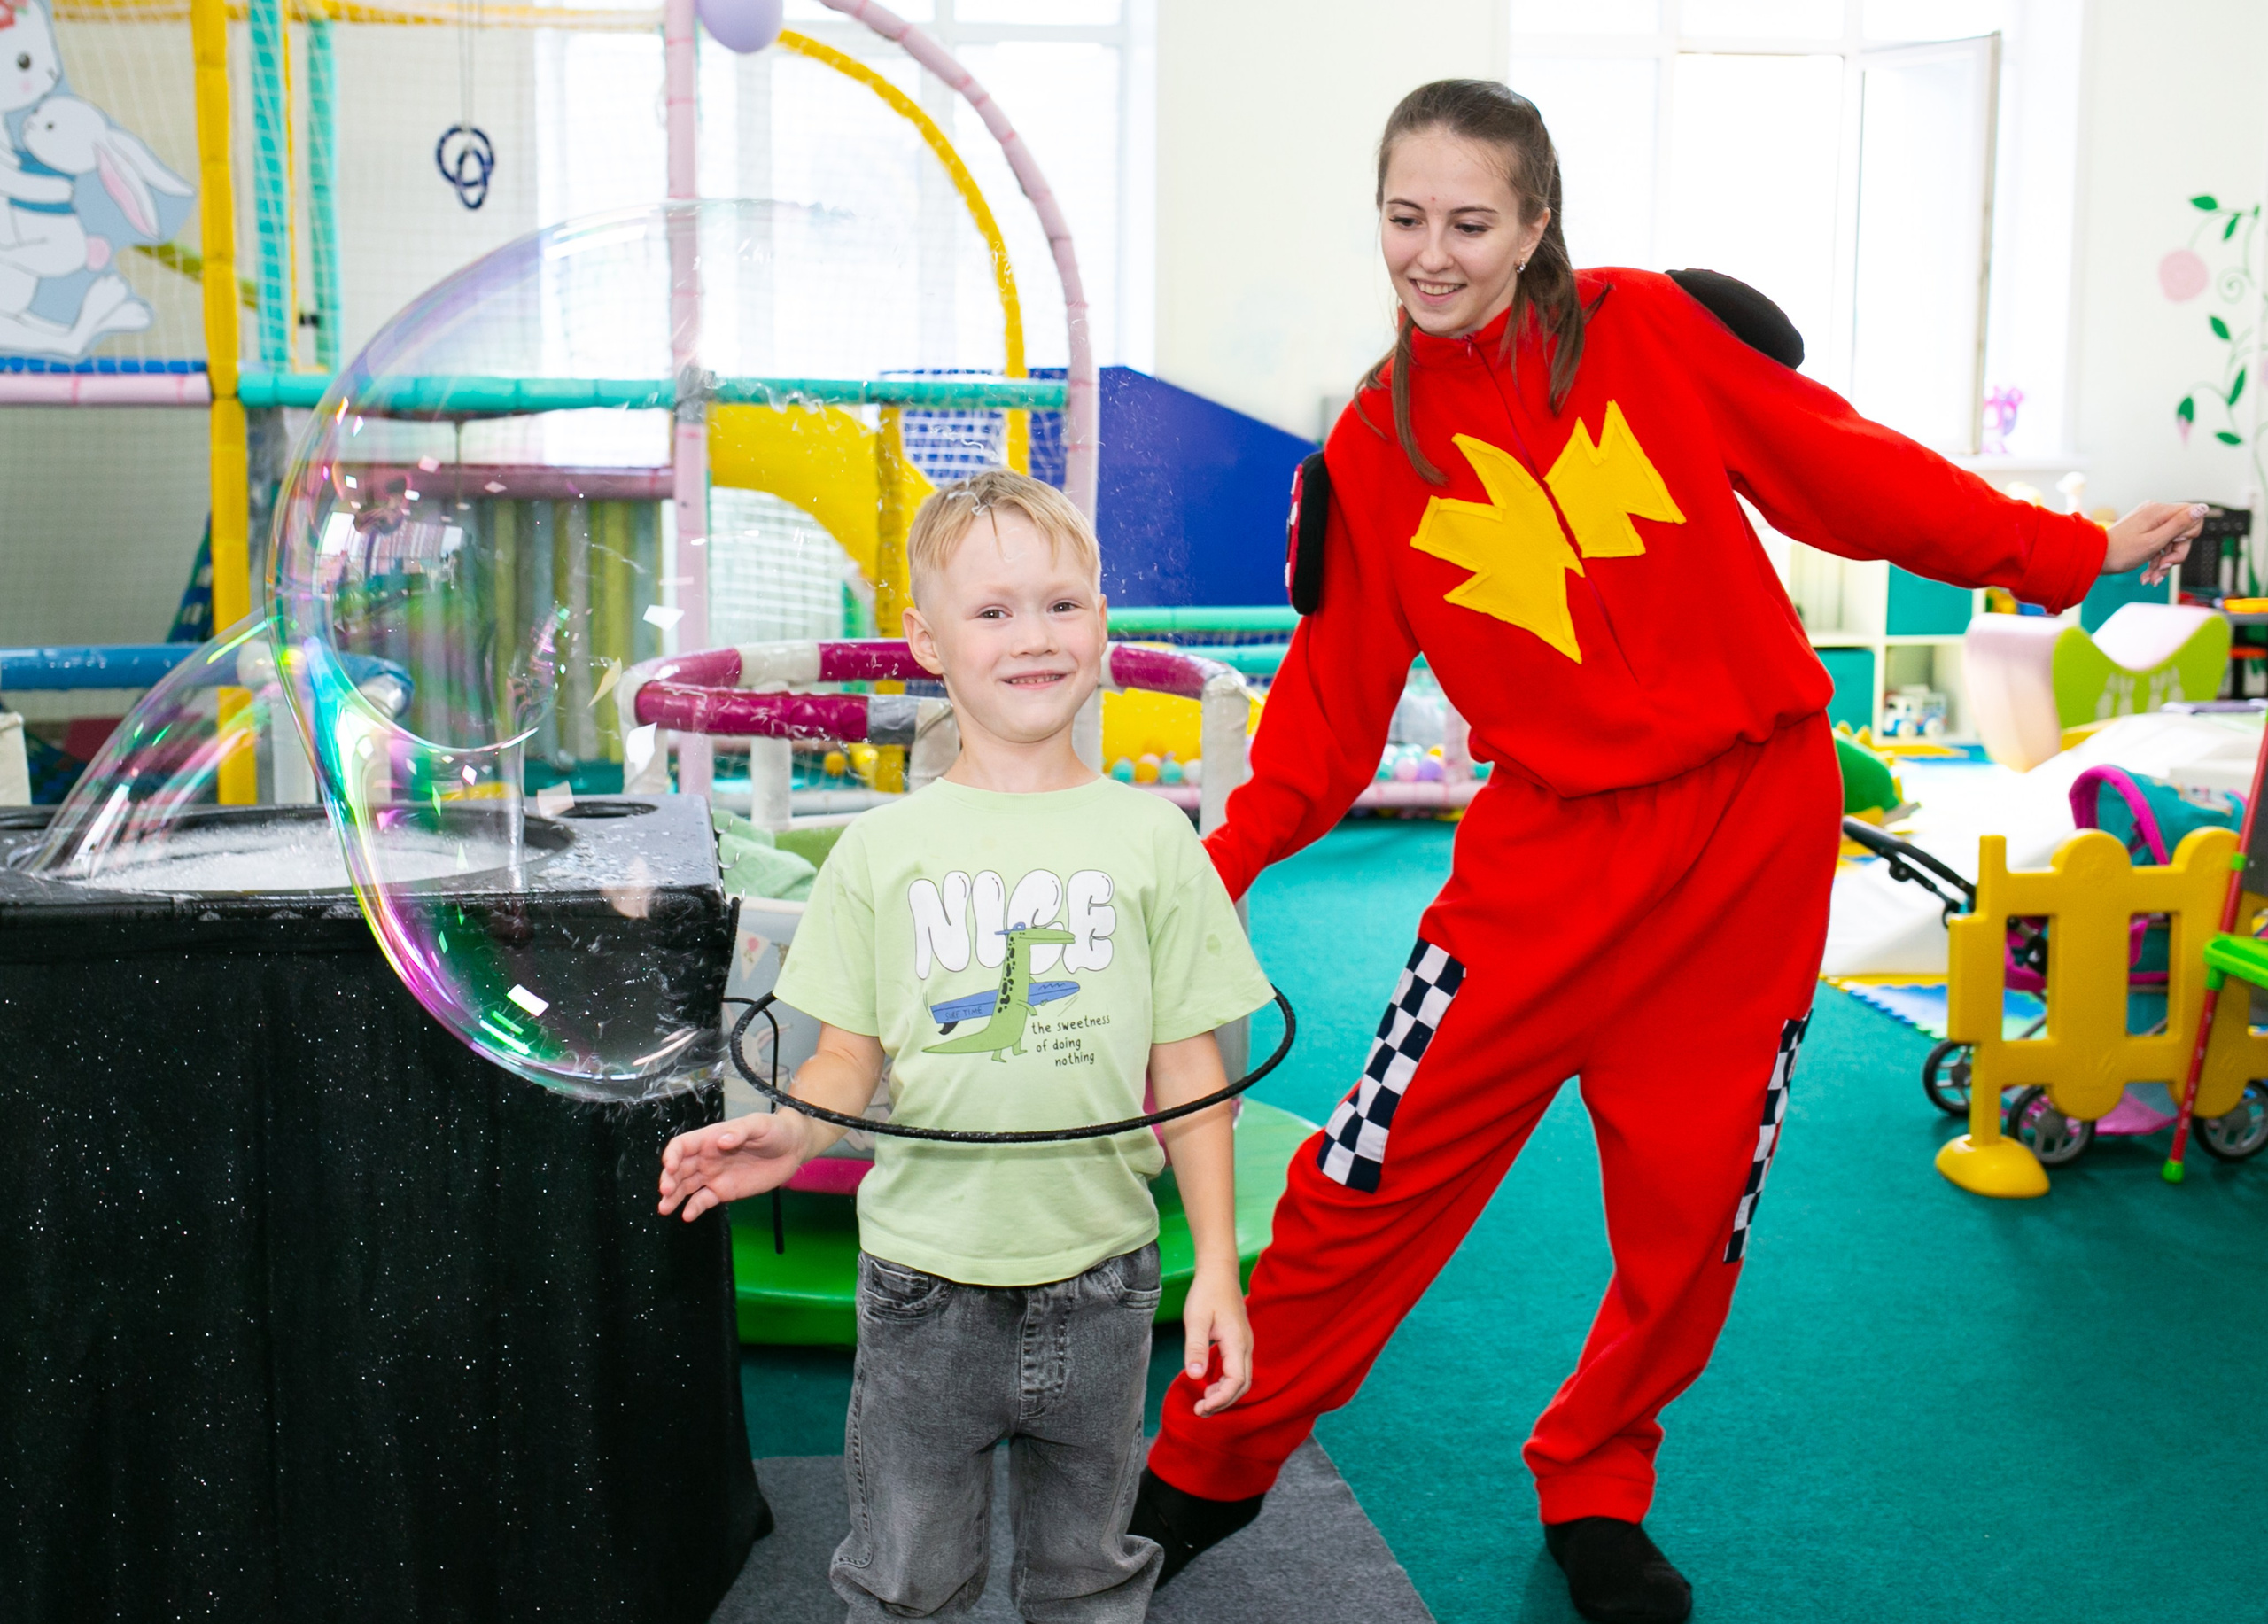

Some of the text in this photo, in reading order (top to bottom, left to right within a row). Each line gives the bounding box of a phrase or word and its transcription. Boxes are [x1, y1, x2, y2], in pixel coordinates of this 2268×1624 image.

[908, 869, 1117, 980] NICE
[963, 1006, 983, 1016] TIME
[1031, 1014, 1111, 1035] the sweetness
[1036, 1037, 1081, 1053] of doing
[1054, 1051, 1095, 1067] nothing
